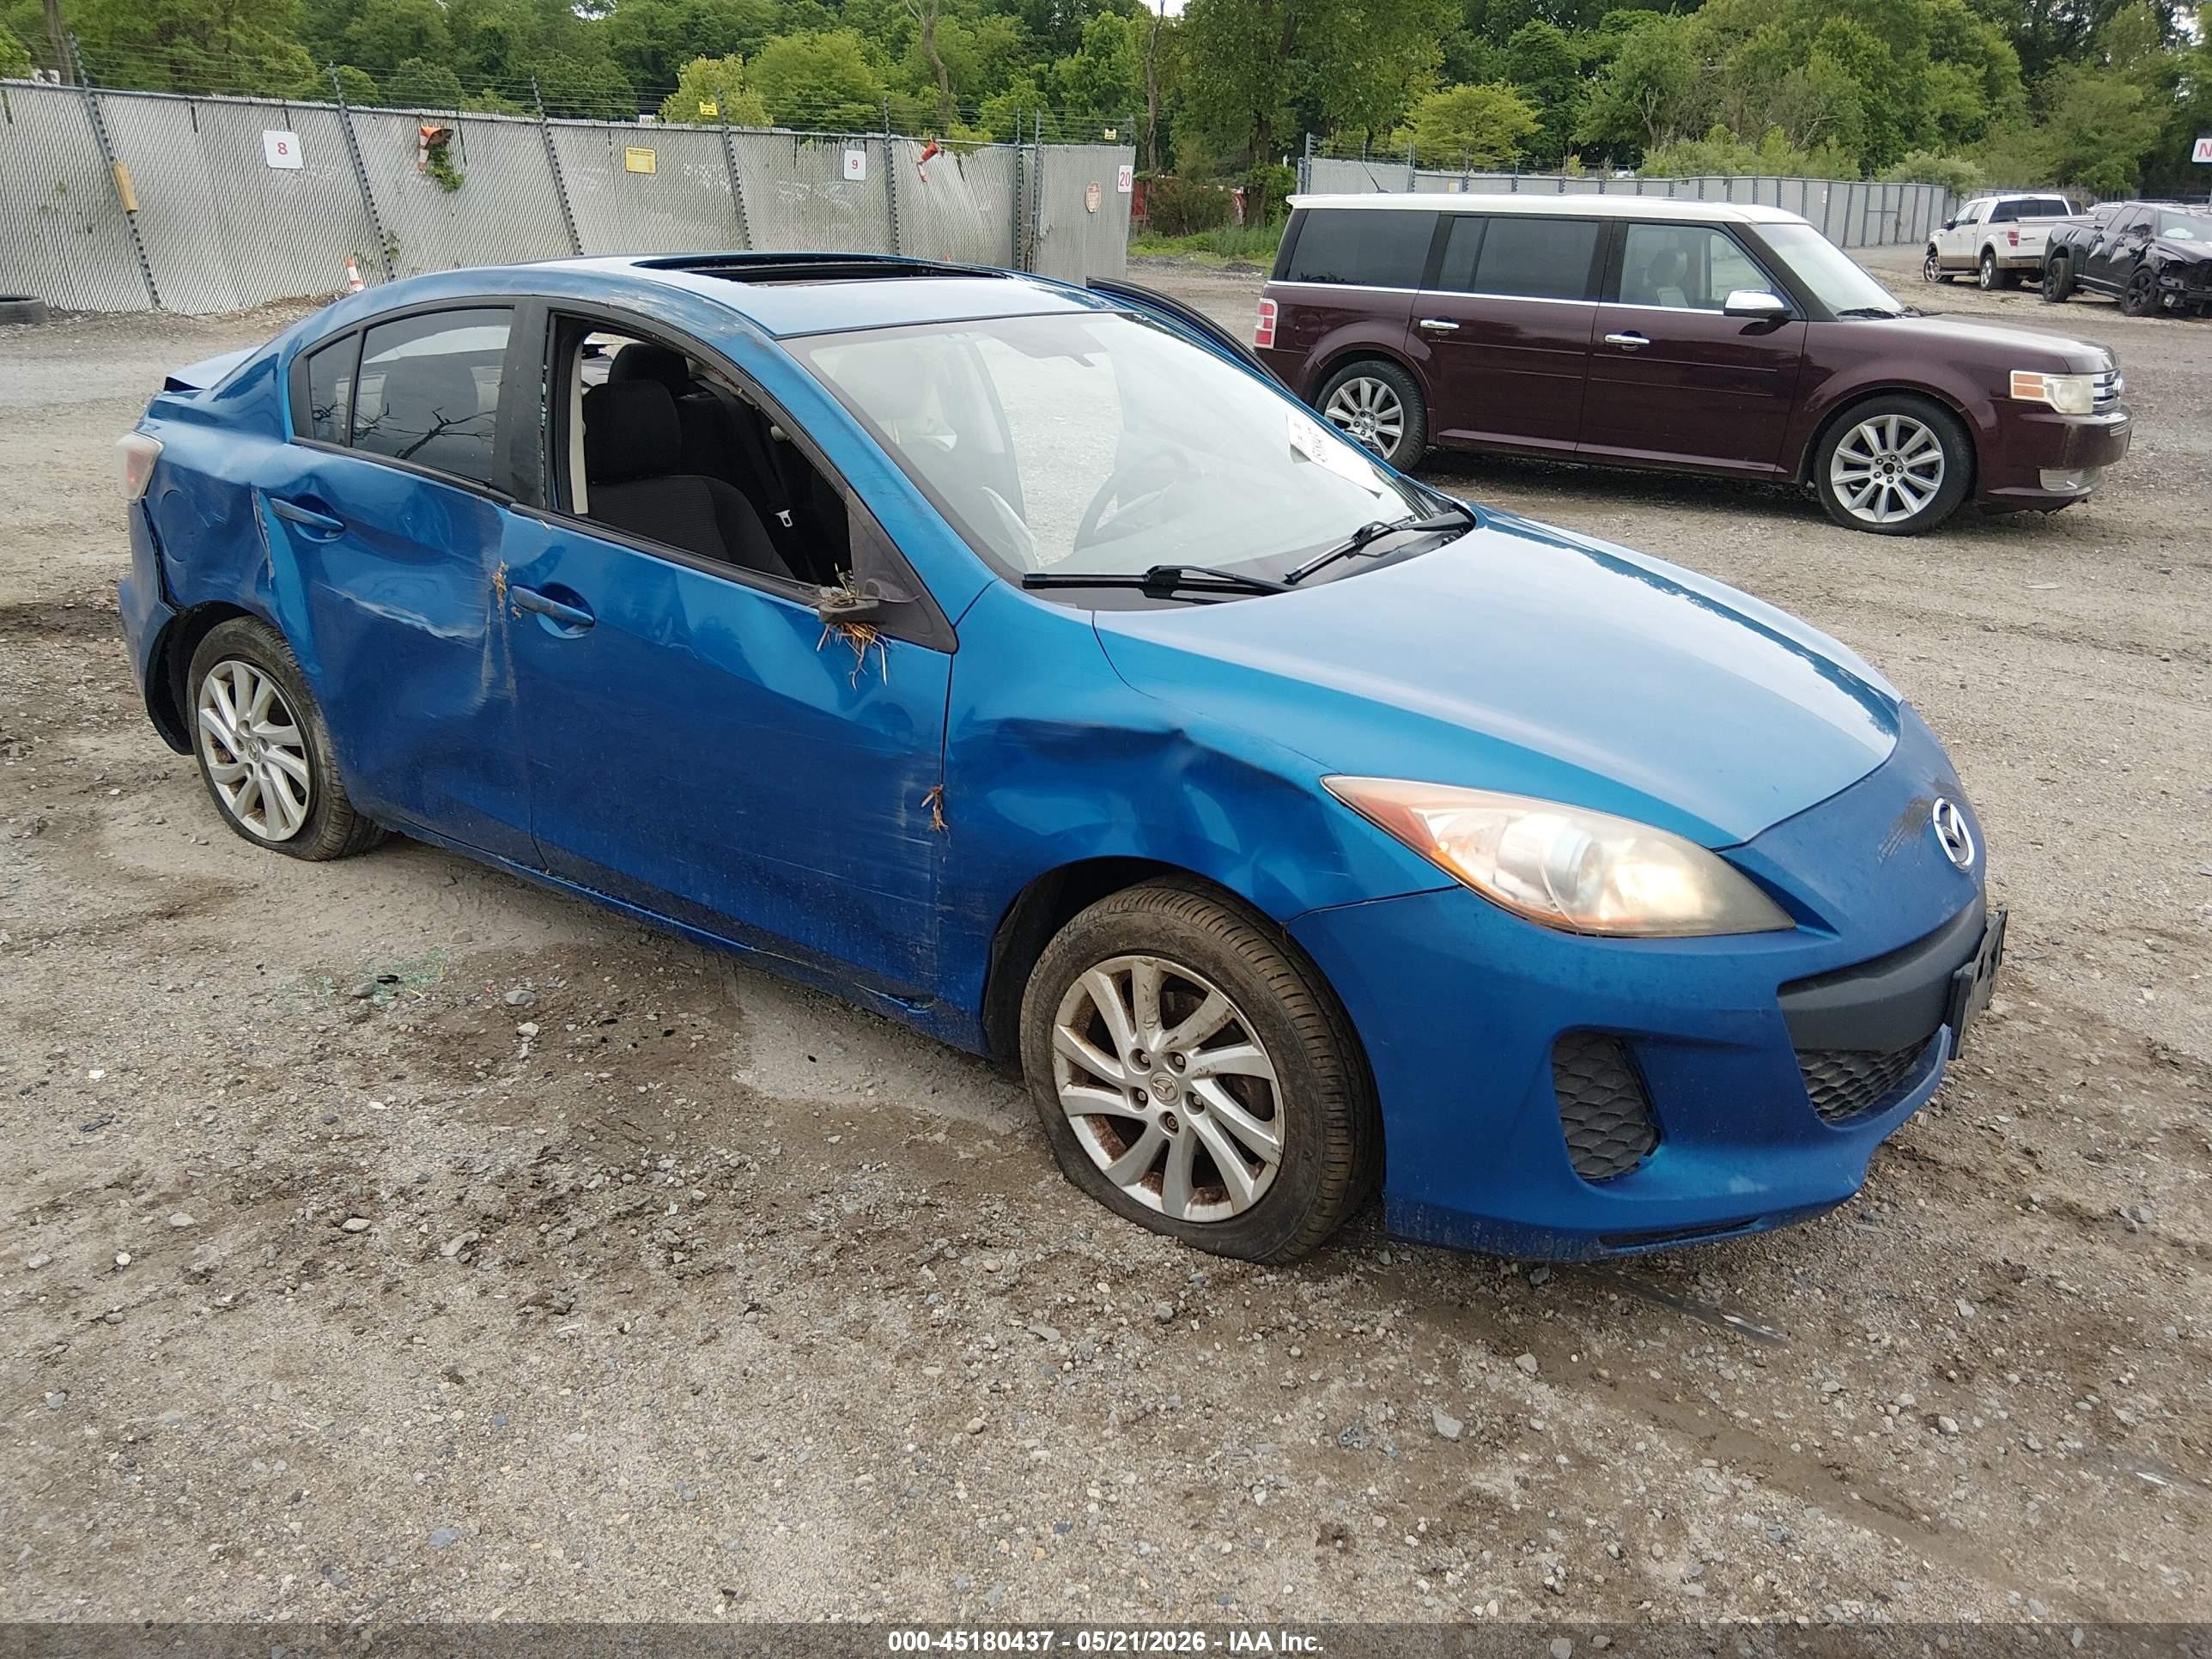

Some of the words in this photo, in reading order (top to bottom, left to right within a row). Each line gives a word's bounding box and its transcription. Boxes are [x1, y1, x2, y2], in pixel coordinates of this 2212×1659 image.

[277, 142, 288, 155] 8
[852, 159, 858, 170] 9
[1119, 172, 1131, 186] 20
